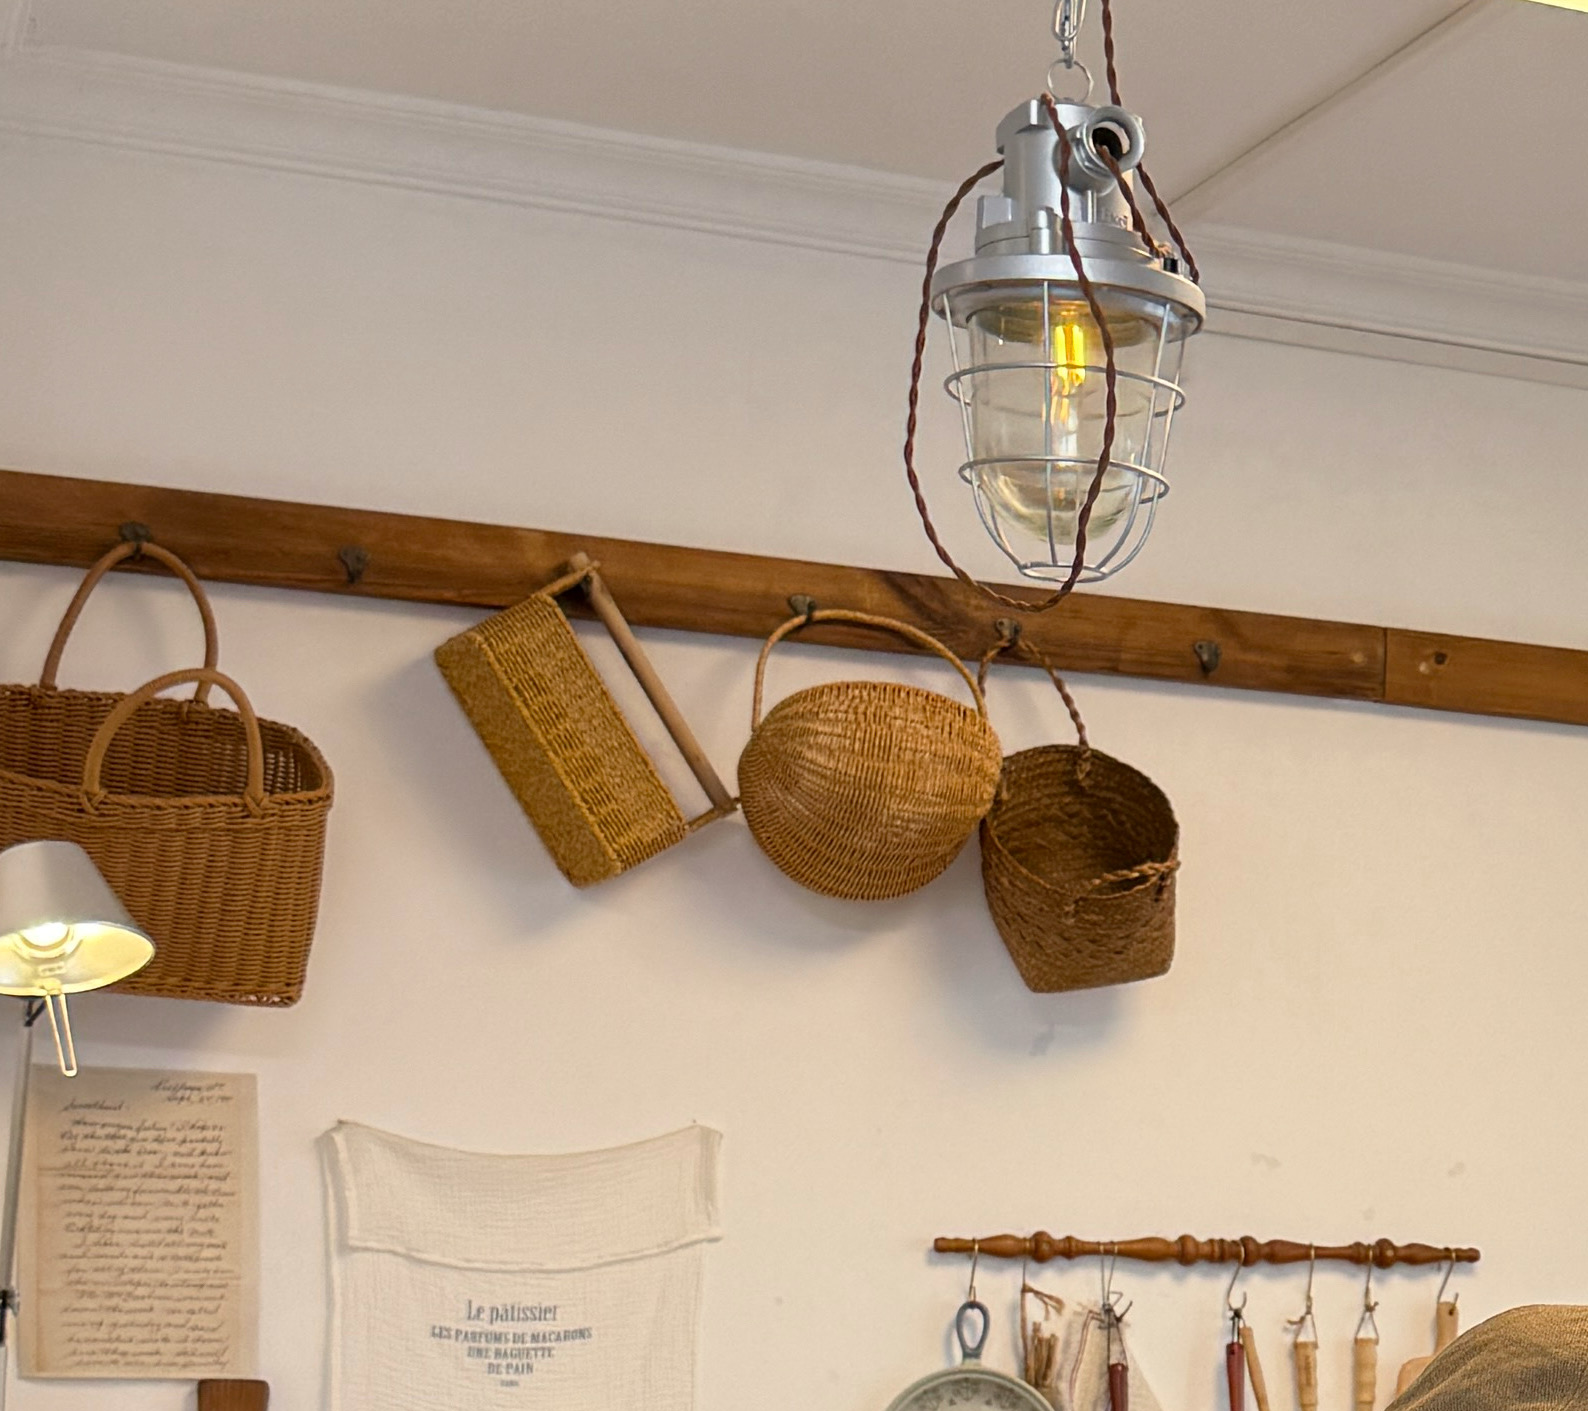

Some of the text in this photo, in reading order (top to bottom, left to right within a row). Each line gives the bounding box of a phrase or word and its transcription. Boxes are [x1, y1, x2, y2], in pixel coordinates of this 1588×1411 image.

[467, 1300, 485, 1321] Le
[431, 1325, 593, 1345] LES PARFUMS DE MACARONS
[494, 1346, 555, 1360] BAGUETTE
[487, 1362, 533, 1375] DE PAIN
